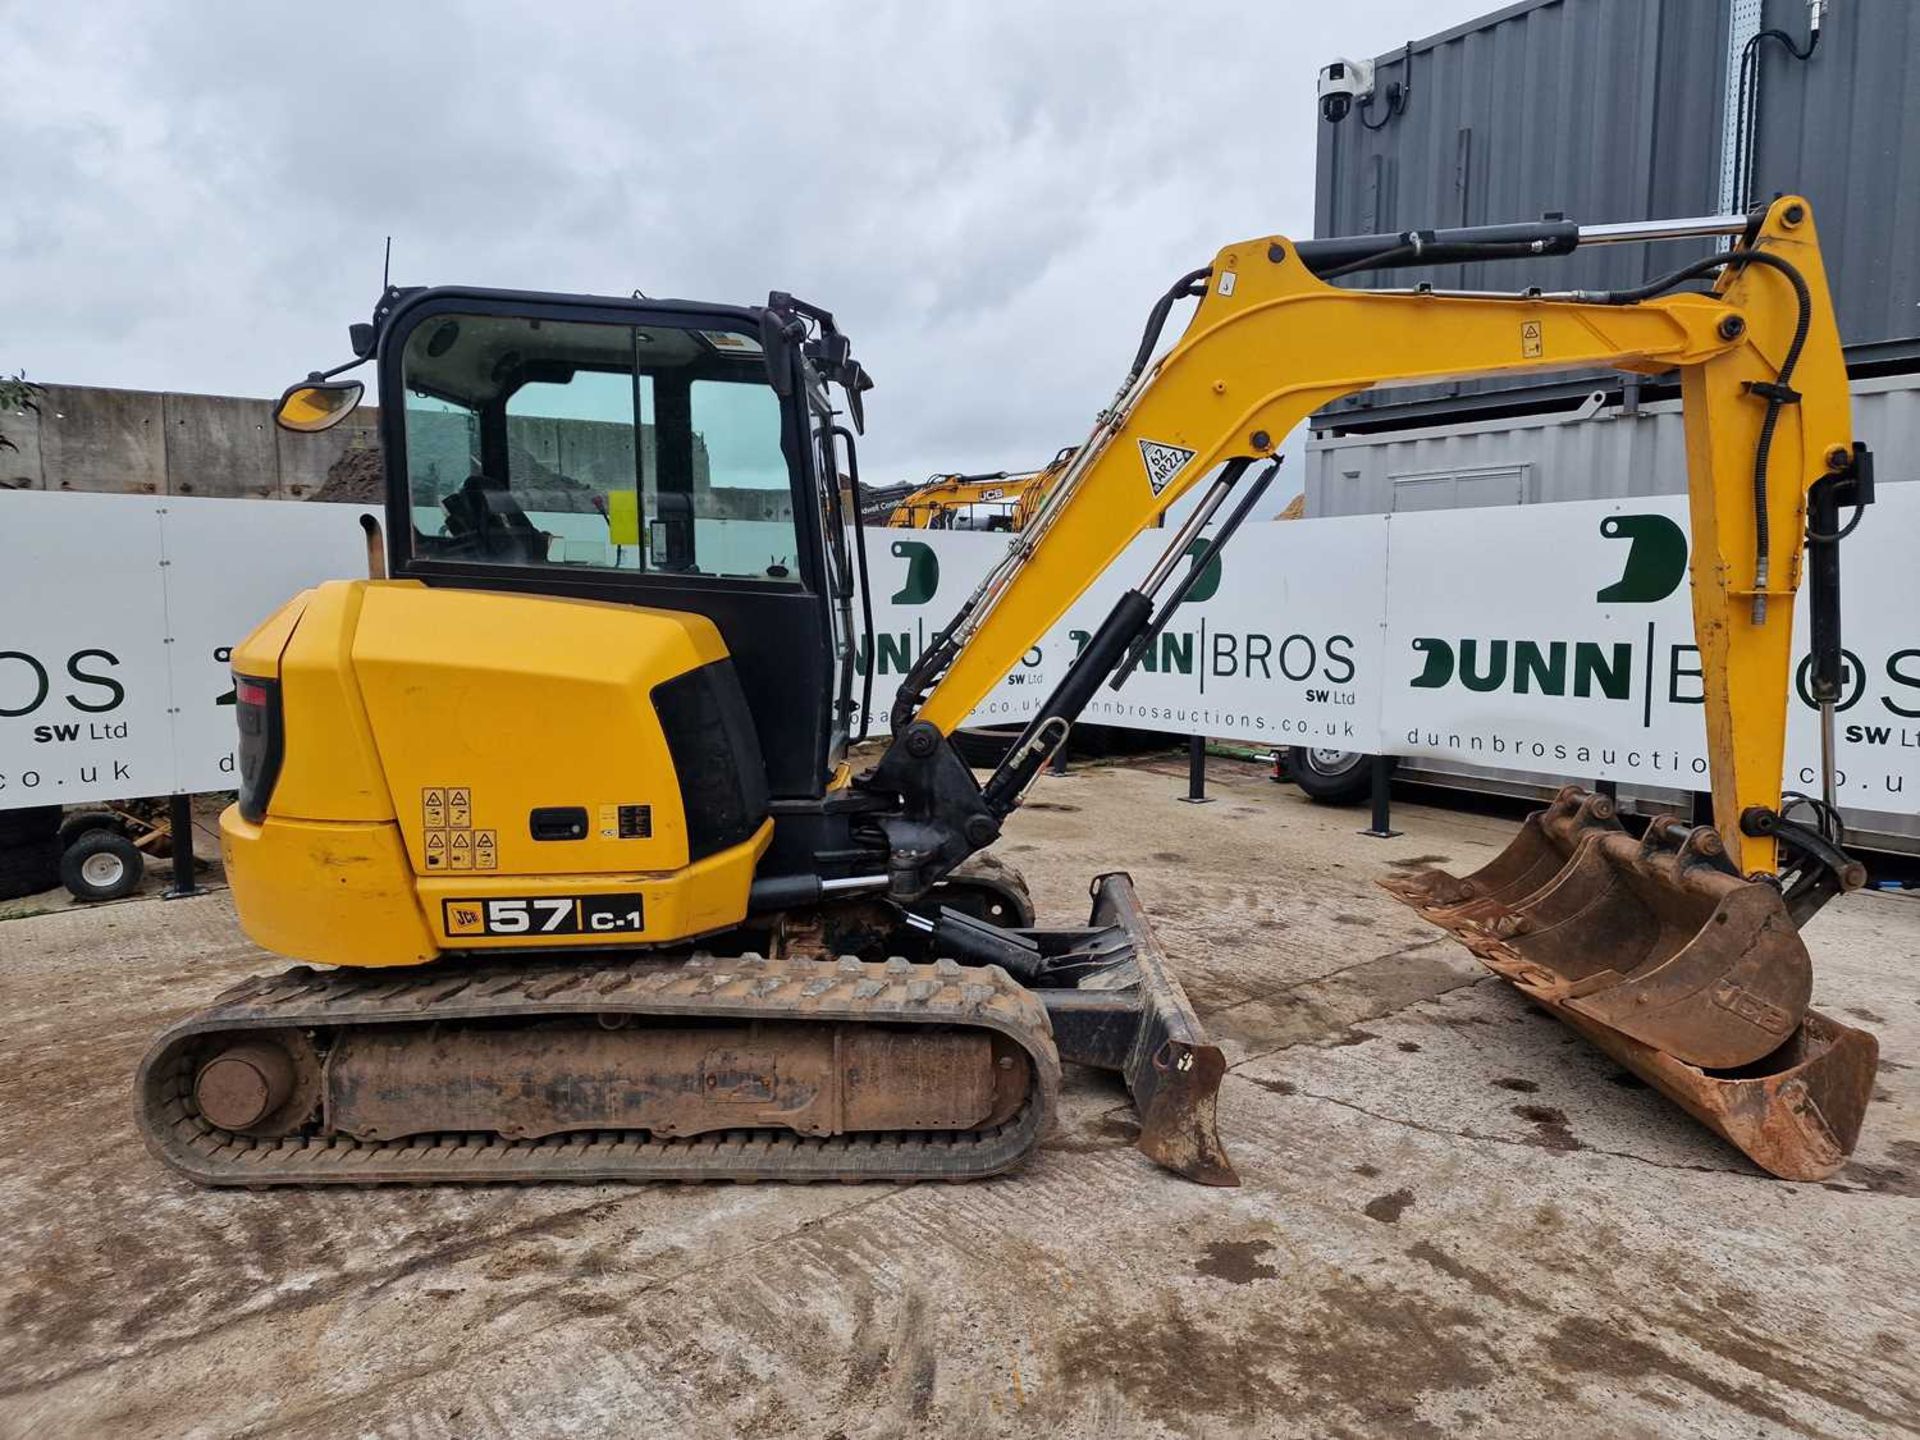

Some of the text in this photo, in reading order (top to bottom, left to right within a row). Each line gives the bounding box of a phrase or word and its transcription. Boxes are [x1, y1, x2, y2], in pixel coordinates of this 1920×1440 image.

[1151, 449, 1167, 466] 62
[979, 488, 1003, 502] JCB
[1213, 633, 1356, 683] BROS
[1008, 674, 1043, 685] SW Ltd
[1410, 638, 1632, 700] DUNN
[1305, 690, 1355, 705] SW Ltd
[1083, 701, 1354, 737] nnbrosauctions.co.uk
[34, 721, 128, 743] SW Ltd
[1845, 725, 1892, 745] SW
[457, 899, 641, 933] JCB 57 C-1
